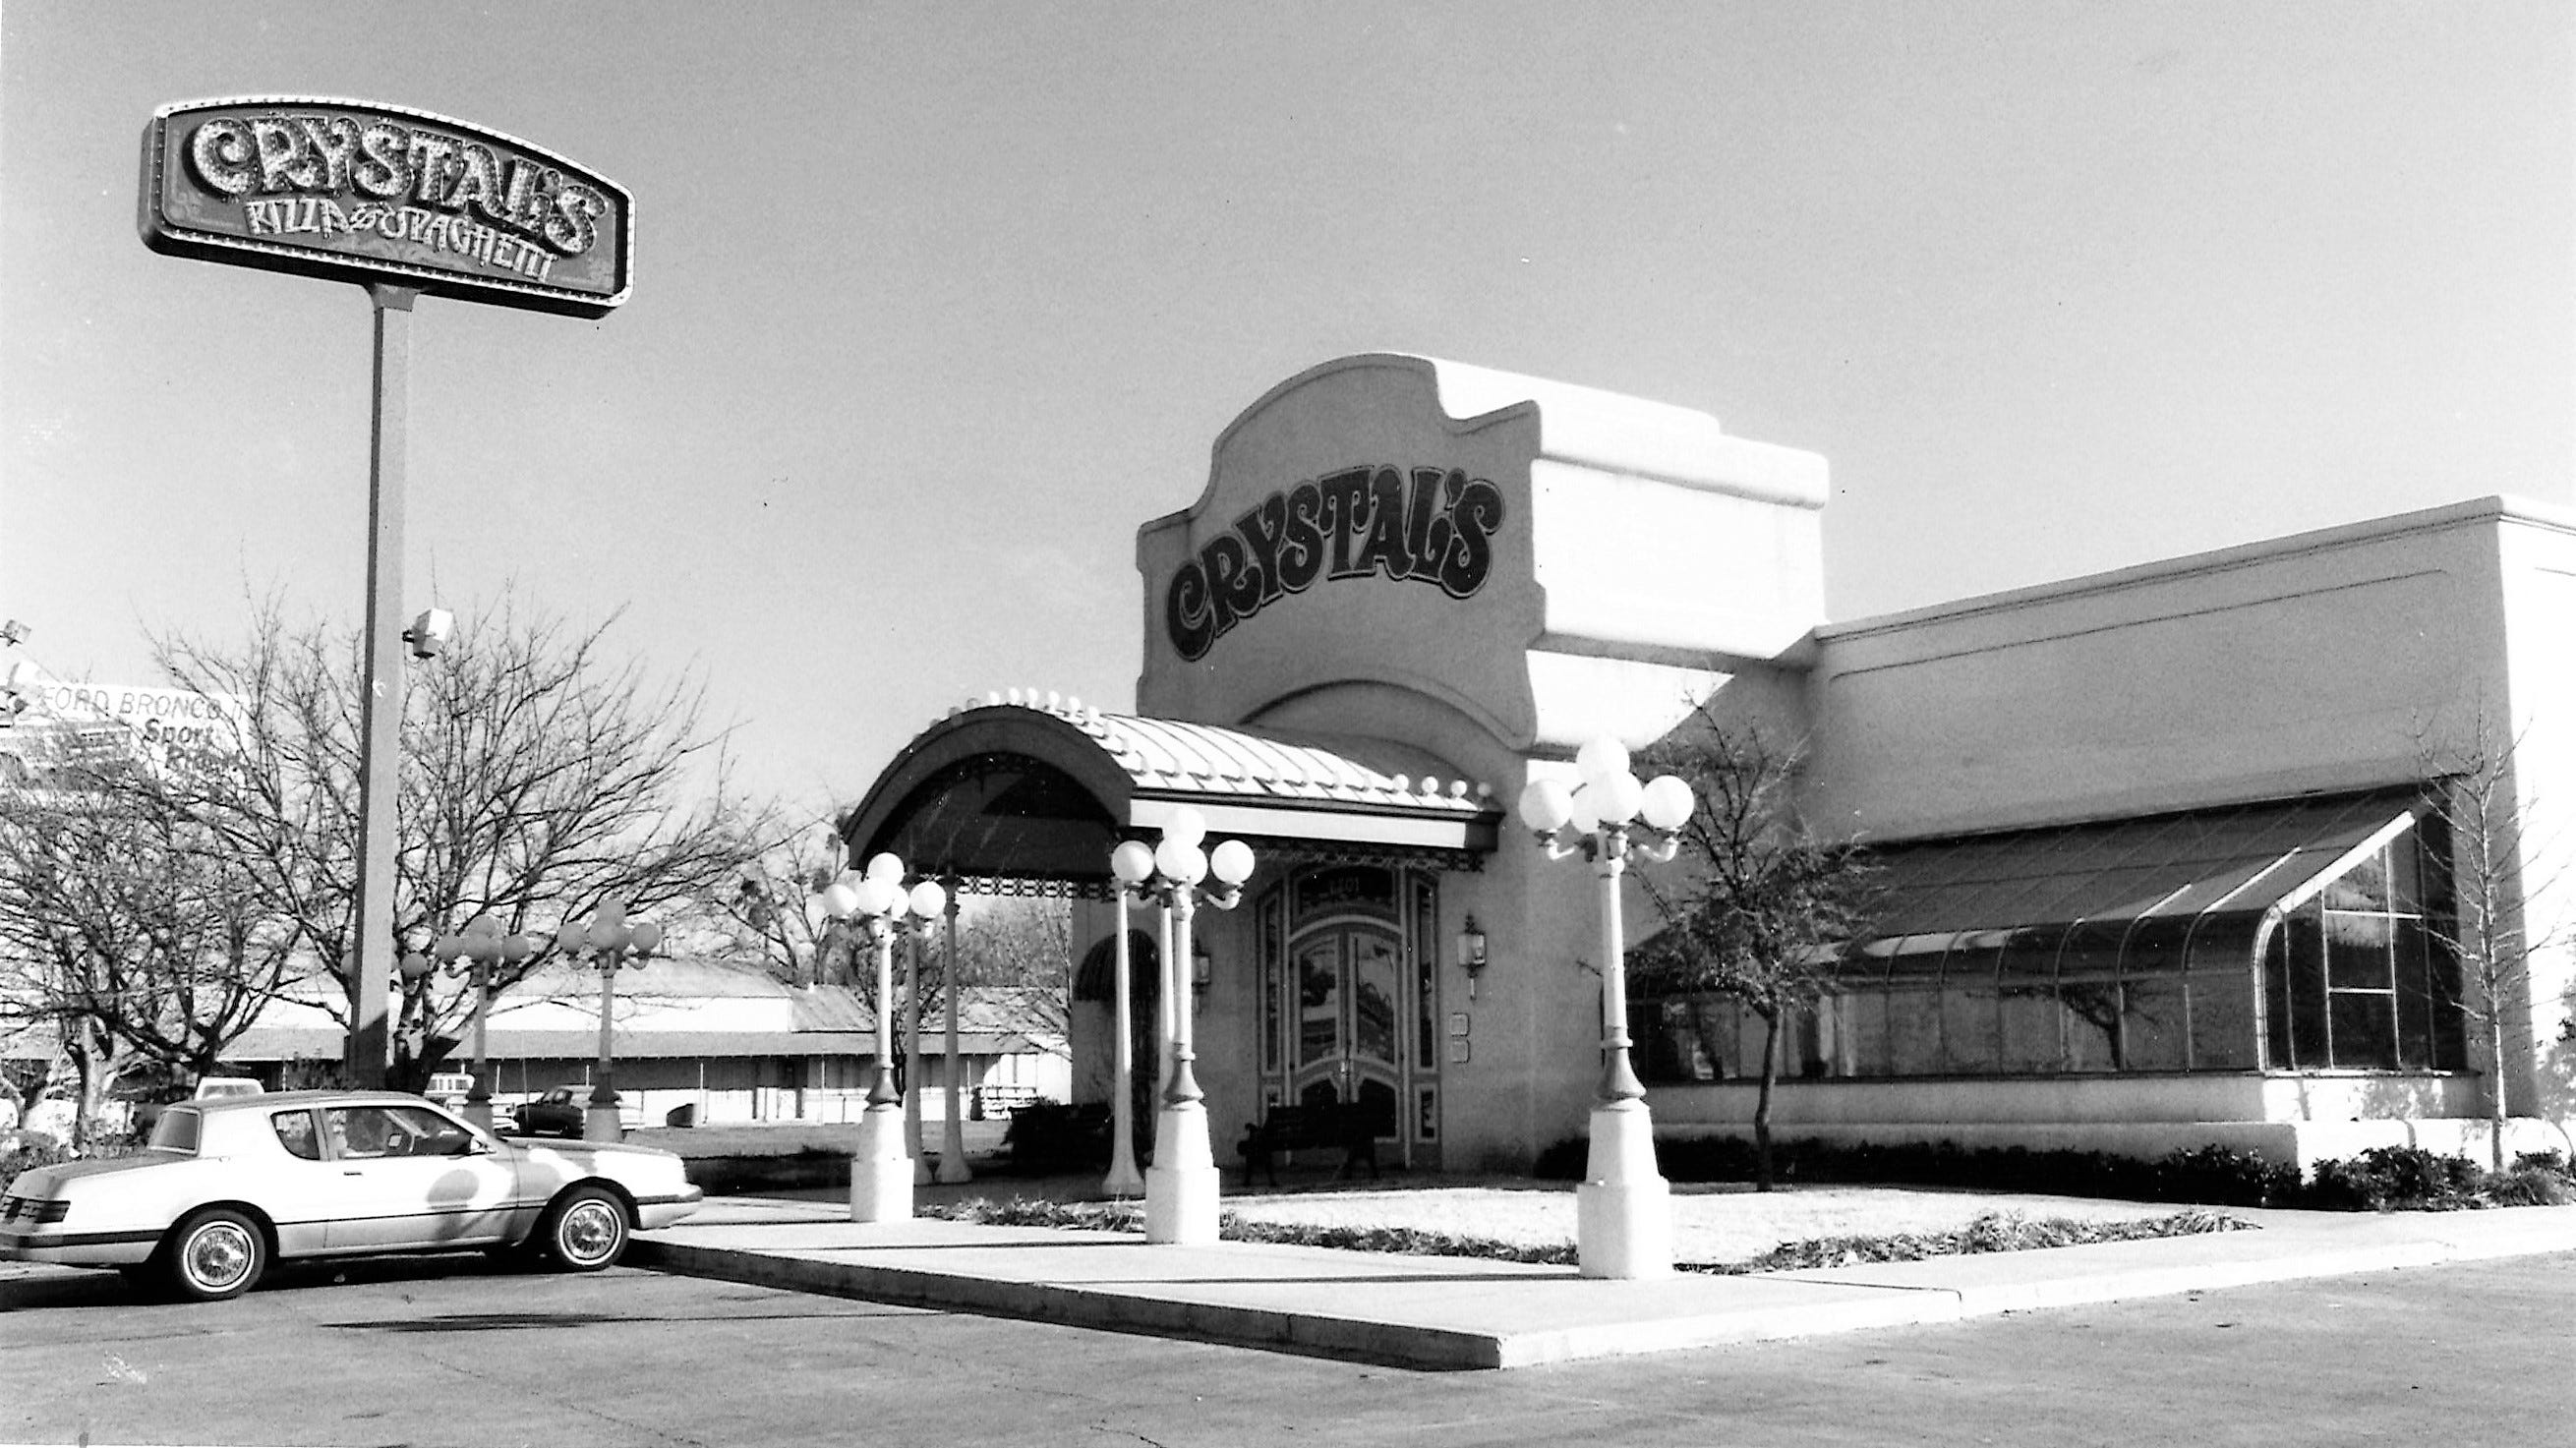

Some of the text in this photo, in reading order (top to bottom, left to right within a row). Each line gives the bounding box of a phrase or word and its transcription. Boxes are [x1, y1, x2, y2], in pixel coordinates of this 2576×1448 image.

[189, 114, 609, 258] CRYSTAL'S
[245, 198, 559, 283] PIZZA & SPAGHETTI
[1166, 464, 1506, 663] CRYSTAL'S
[119, 692, 222, 721] BRONCO
